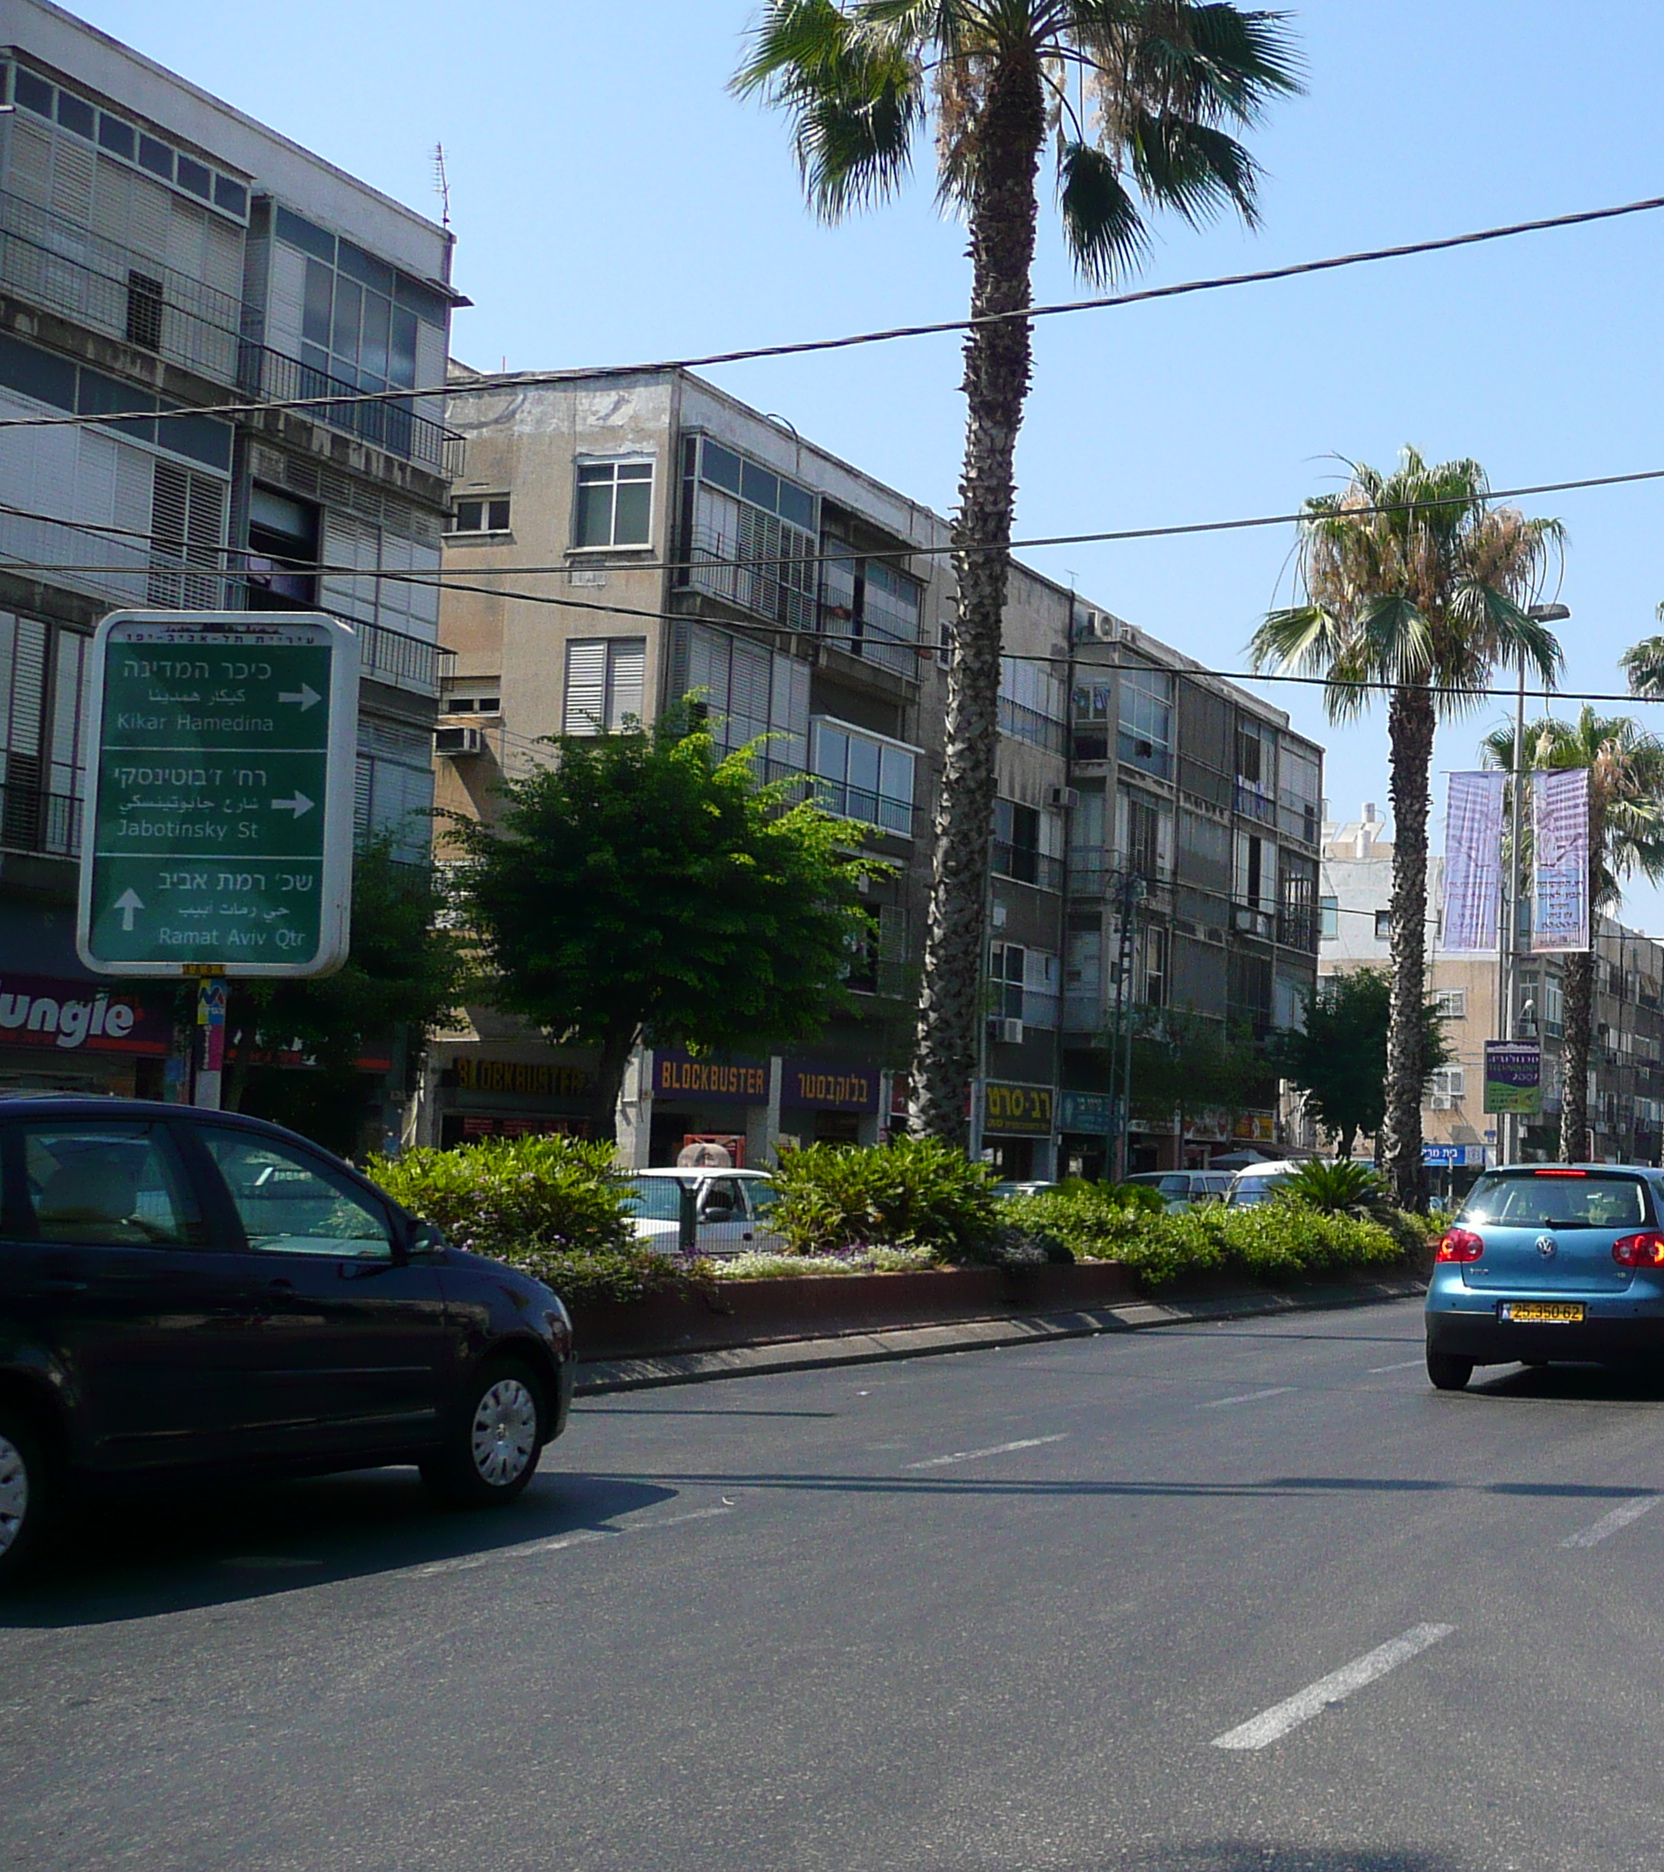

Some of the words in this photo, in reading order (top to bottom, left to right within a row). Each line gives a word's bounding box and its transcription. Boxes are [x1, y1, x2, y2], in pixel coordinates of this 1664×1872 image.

[123, 660, 209, 679] המדינה
[221, 660, 272, 680] כיכר
[117, 714, 166, 731] Kikar
[177, 714, 273, 732] Hamedina
[113, 767, 222, 790] ז'בוטינסקי
[232, 768, 267, 787] רח'
[117, 821, 228, 842] Jabotinsky
[238, 821, 258, 839] St
[158, 872, 208, 891] אביב
[216, 872, 266, 891] רמת
[159, 928, 219, 946] Ramat
[228, 928, 266, 946] Aviv
[275, 929, 306, 947] Qtr
[0, 986, 135, 1048] ungle
[457, 1058, 587, 1096] BLOCKBUSTER
[661, 1061, 764, 1095] BLOCKBUSTER
[798, 1073, 867, 1105] בלוקבסטר
